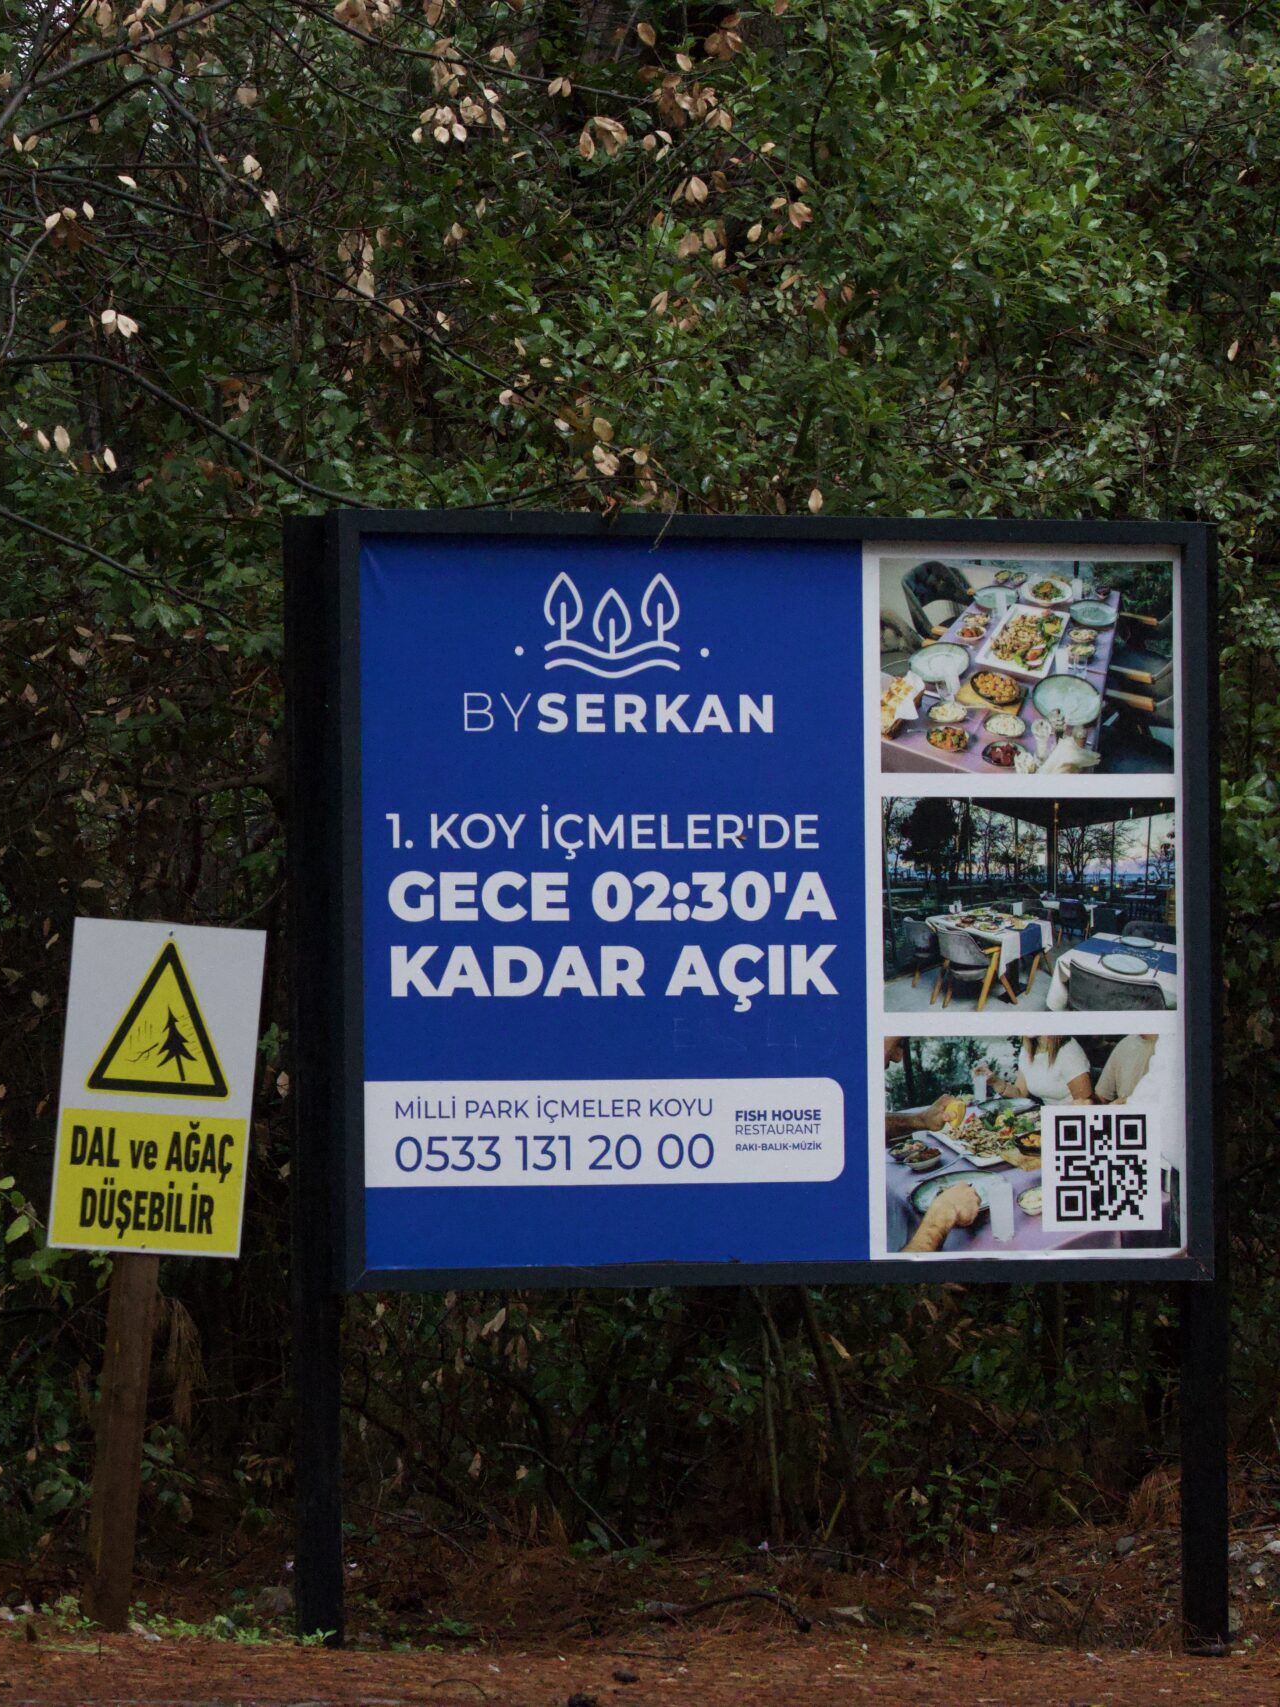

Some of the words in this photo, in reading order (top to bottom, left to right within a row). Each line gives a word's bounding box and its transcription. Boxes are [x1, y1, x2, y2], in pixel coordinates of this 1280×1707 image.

[385, 813, 414, 849] 1.
[430, 813, 526, 850] KOY
[541, 803, 820, 860] İÇMELER'DE
[388, 870, 570, 923] GECE
[591, 870, 838, 922] 02:30'A
[390, 945, 646, 997] KADAR
[664, 943, 839, 1013] AÇIK
[395, 1095, 456, 1120] MİLLİ
[465, 1099, 529, 1119] PARK
[537, 1095, 641, 1124] İÇMELER
[649, 1098, 713, 1117] KOYU
[735, 1109, 768, 1122] FISH
[771, 1109, 822, 1122] HOUSE
[735, 1123, 821, 1136] RESTAURANT
[69, 1125, 120, 1168] DAL
[129, 1139, 158, 1171] ve
[164, 1120, 235, 1184] AĞAÇ
[395, 1135, 502, 1173] 0533
[514, 1135, 571, 1171] 131
[587, 1134, 642, 1171] 20
[657, 1133, 715, 1170] 00
[79, 1176, 215, 1240] DÜŞEBİLİR
